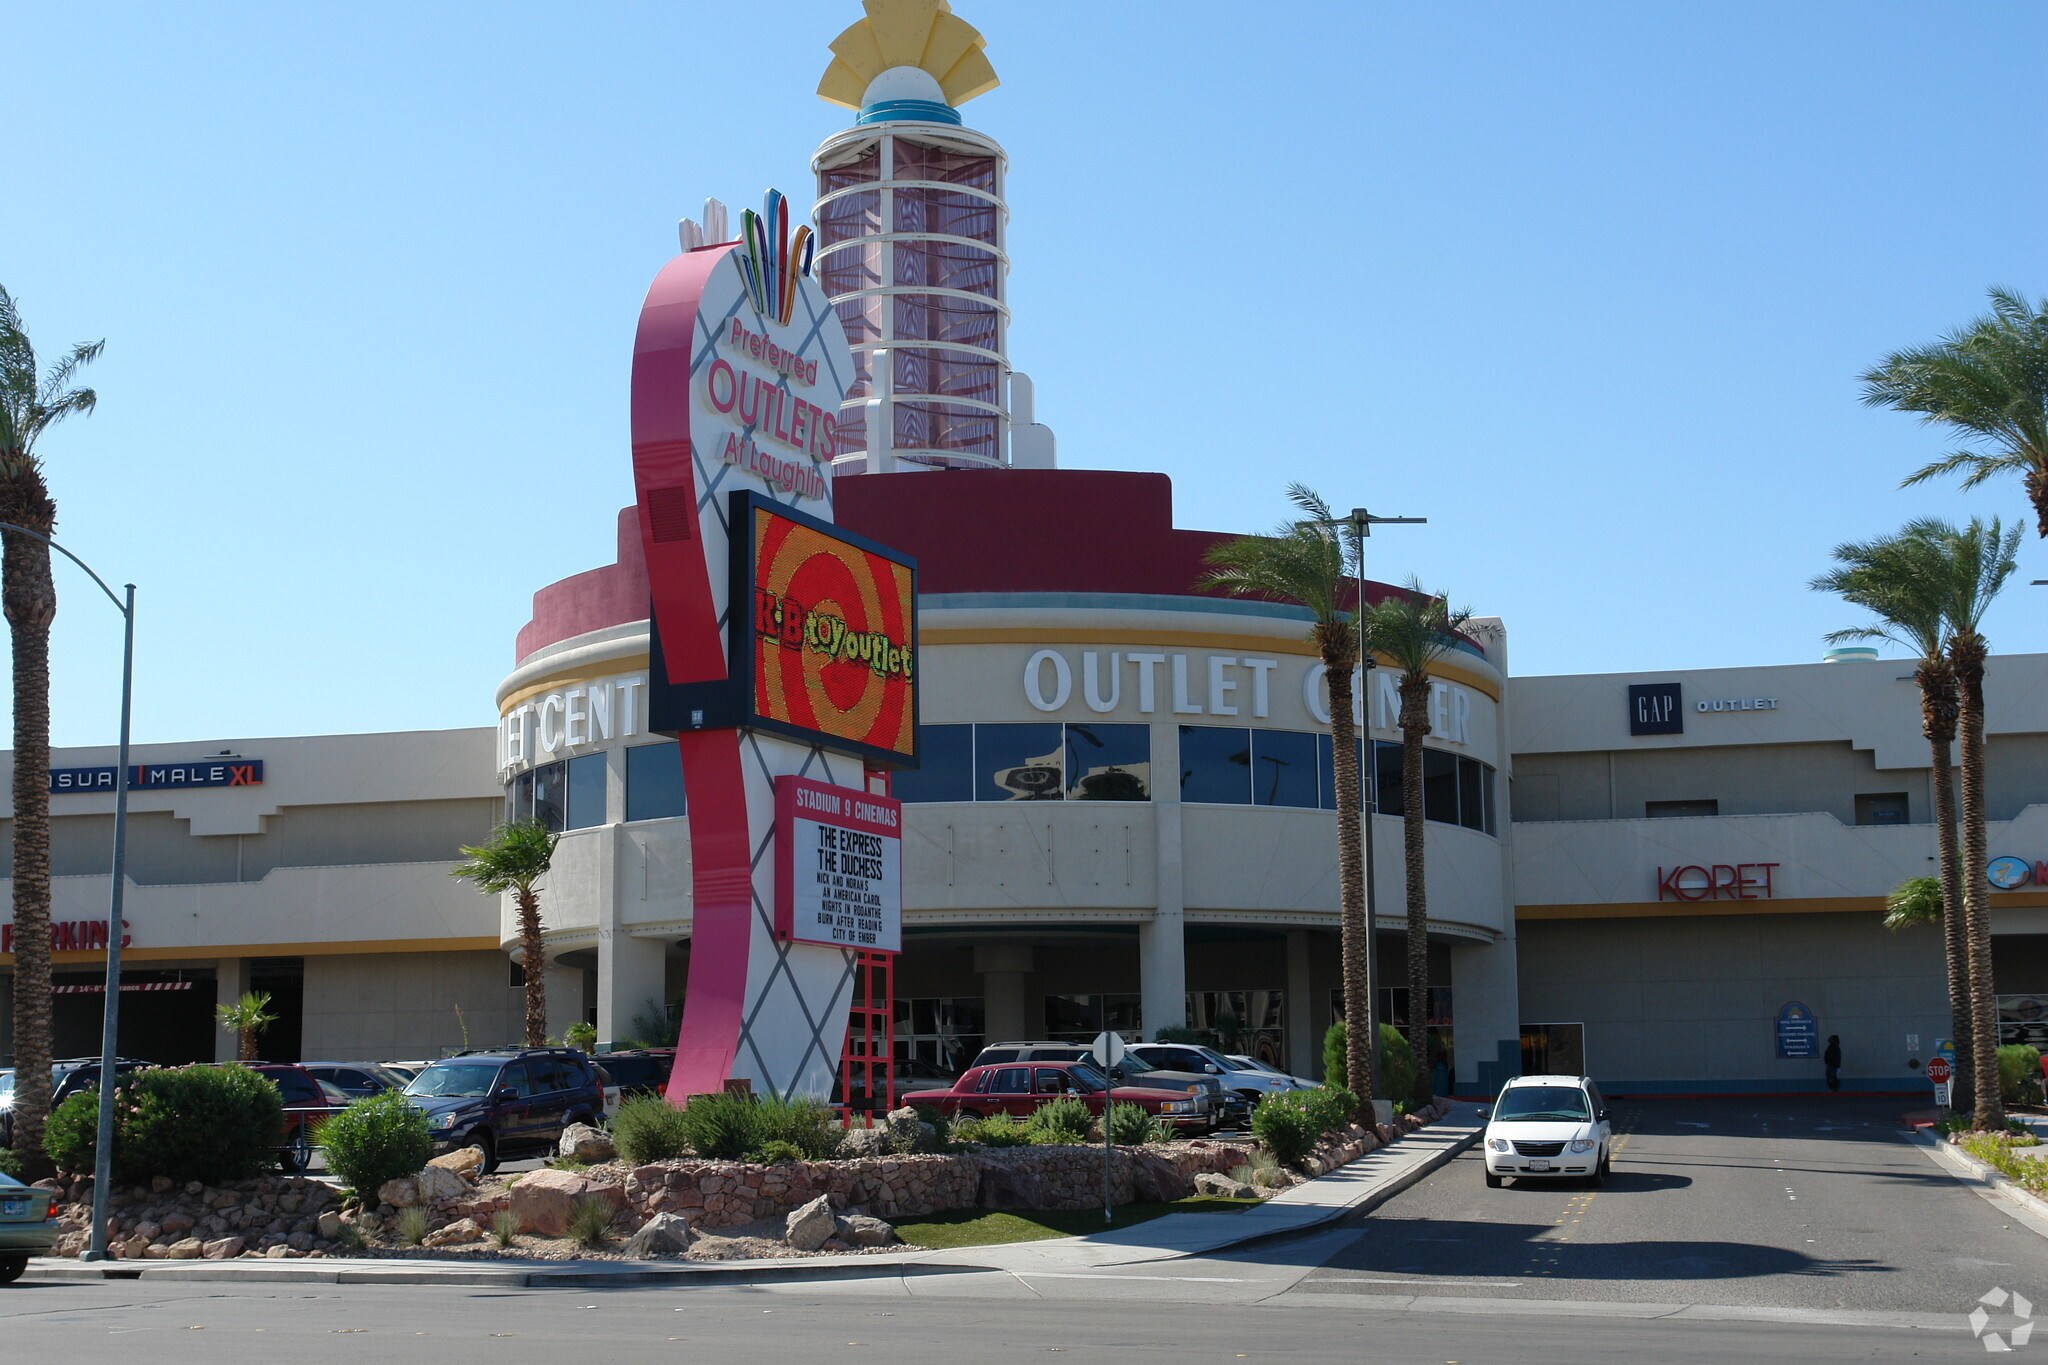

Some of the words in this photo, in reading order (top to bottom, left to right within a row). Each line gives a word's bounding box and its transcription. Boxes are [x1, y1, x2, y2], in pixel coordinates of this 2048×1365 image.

[731, 317, 818, 387] Preferred
[708, 358, 837, 462] OUTLETS
[723, 432, 745, 465] At
[750, 441, 825, 500] Laughlin
[1023, 649, 1277, 717] OUTLET
[1303, 663, 1470, 745] CENER
[1638, 695, 1673, 723] GAP
[1697, 698, 1778, 713] OUTLET
[151, 767, 225, 783] MALE
[229, 765, 263, 786] XL
[796, 788, 840, 815] STADIUM
[844, 799, 851, 817] 9
[855, 801, 897, 827] CINEMAS
[818, 825, 837, 849] THE
[840, 829, 882, 858] EXPRESS
[817, 848, 837, 873] THE
[841, 853, 883, 880] DUCHESS
[816, 872, 830, 885] NICK
[832, 875, 844, 887] AND
[1657, 862, 1780, 901] KORET
[821, 899, 842, 914] NIGHTS
[844, 903, 851, 915] IN
[853, 904, 882, 920] RODANTHE
[823, 886, 831, 898] AN
[833, 888, 862, 904] AMERICAN
[863, 893, 881, 906] CAROL
[2, 919, 131, 951] PRKING
[817, 912, 834, 926] BURN
[836, 915, 855, 929] AFTER
[857, 918, 883, 933] READING
[832, 927, 846, 940] CITY
[848, 930, 856, 942] OF
[858, 931, 877, 945] EMBER
[1928, 1065, 1950, 1076] STOP
[1937, 1094, 1947, 1103] 10
